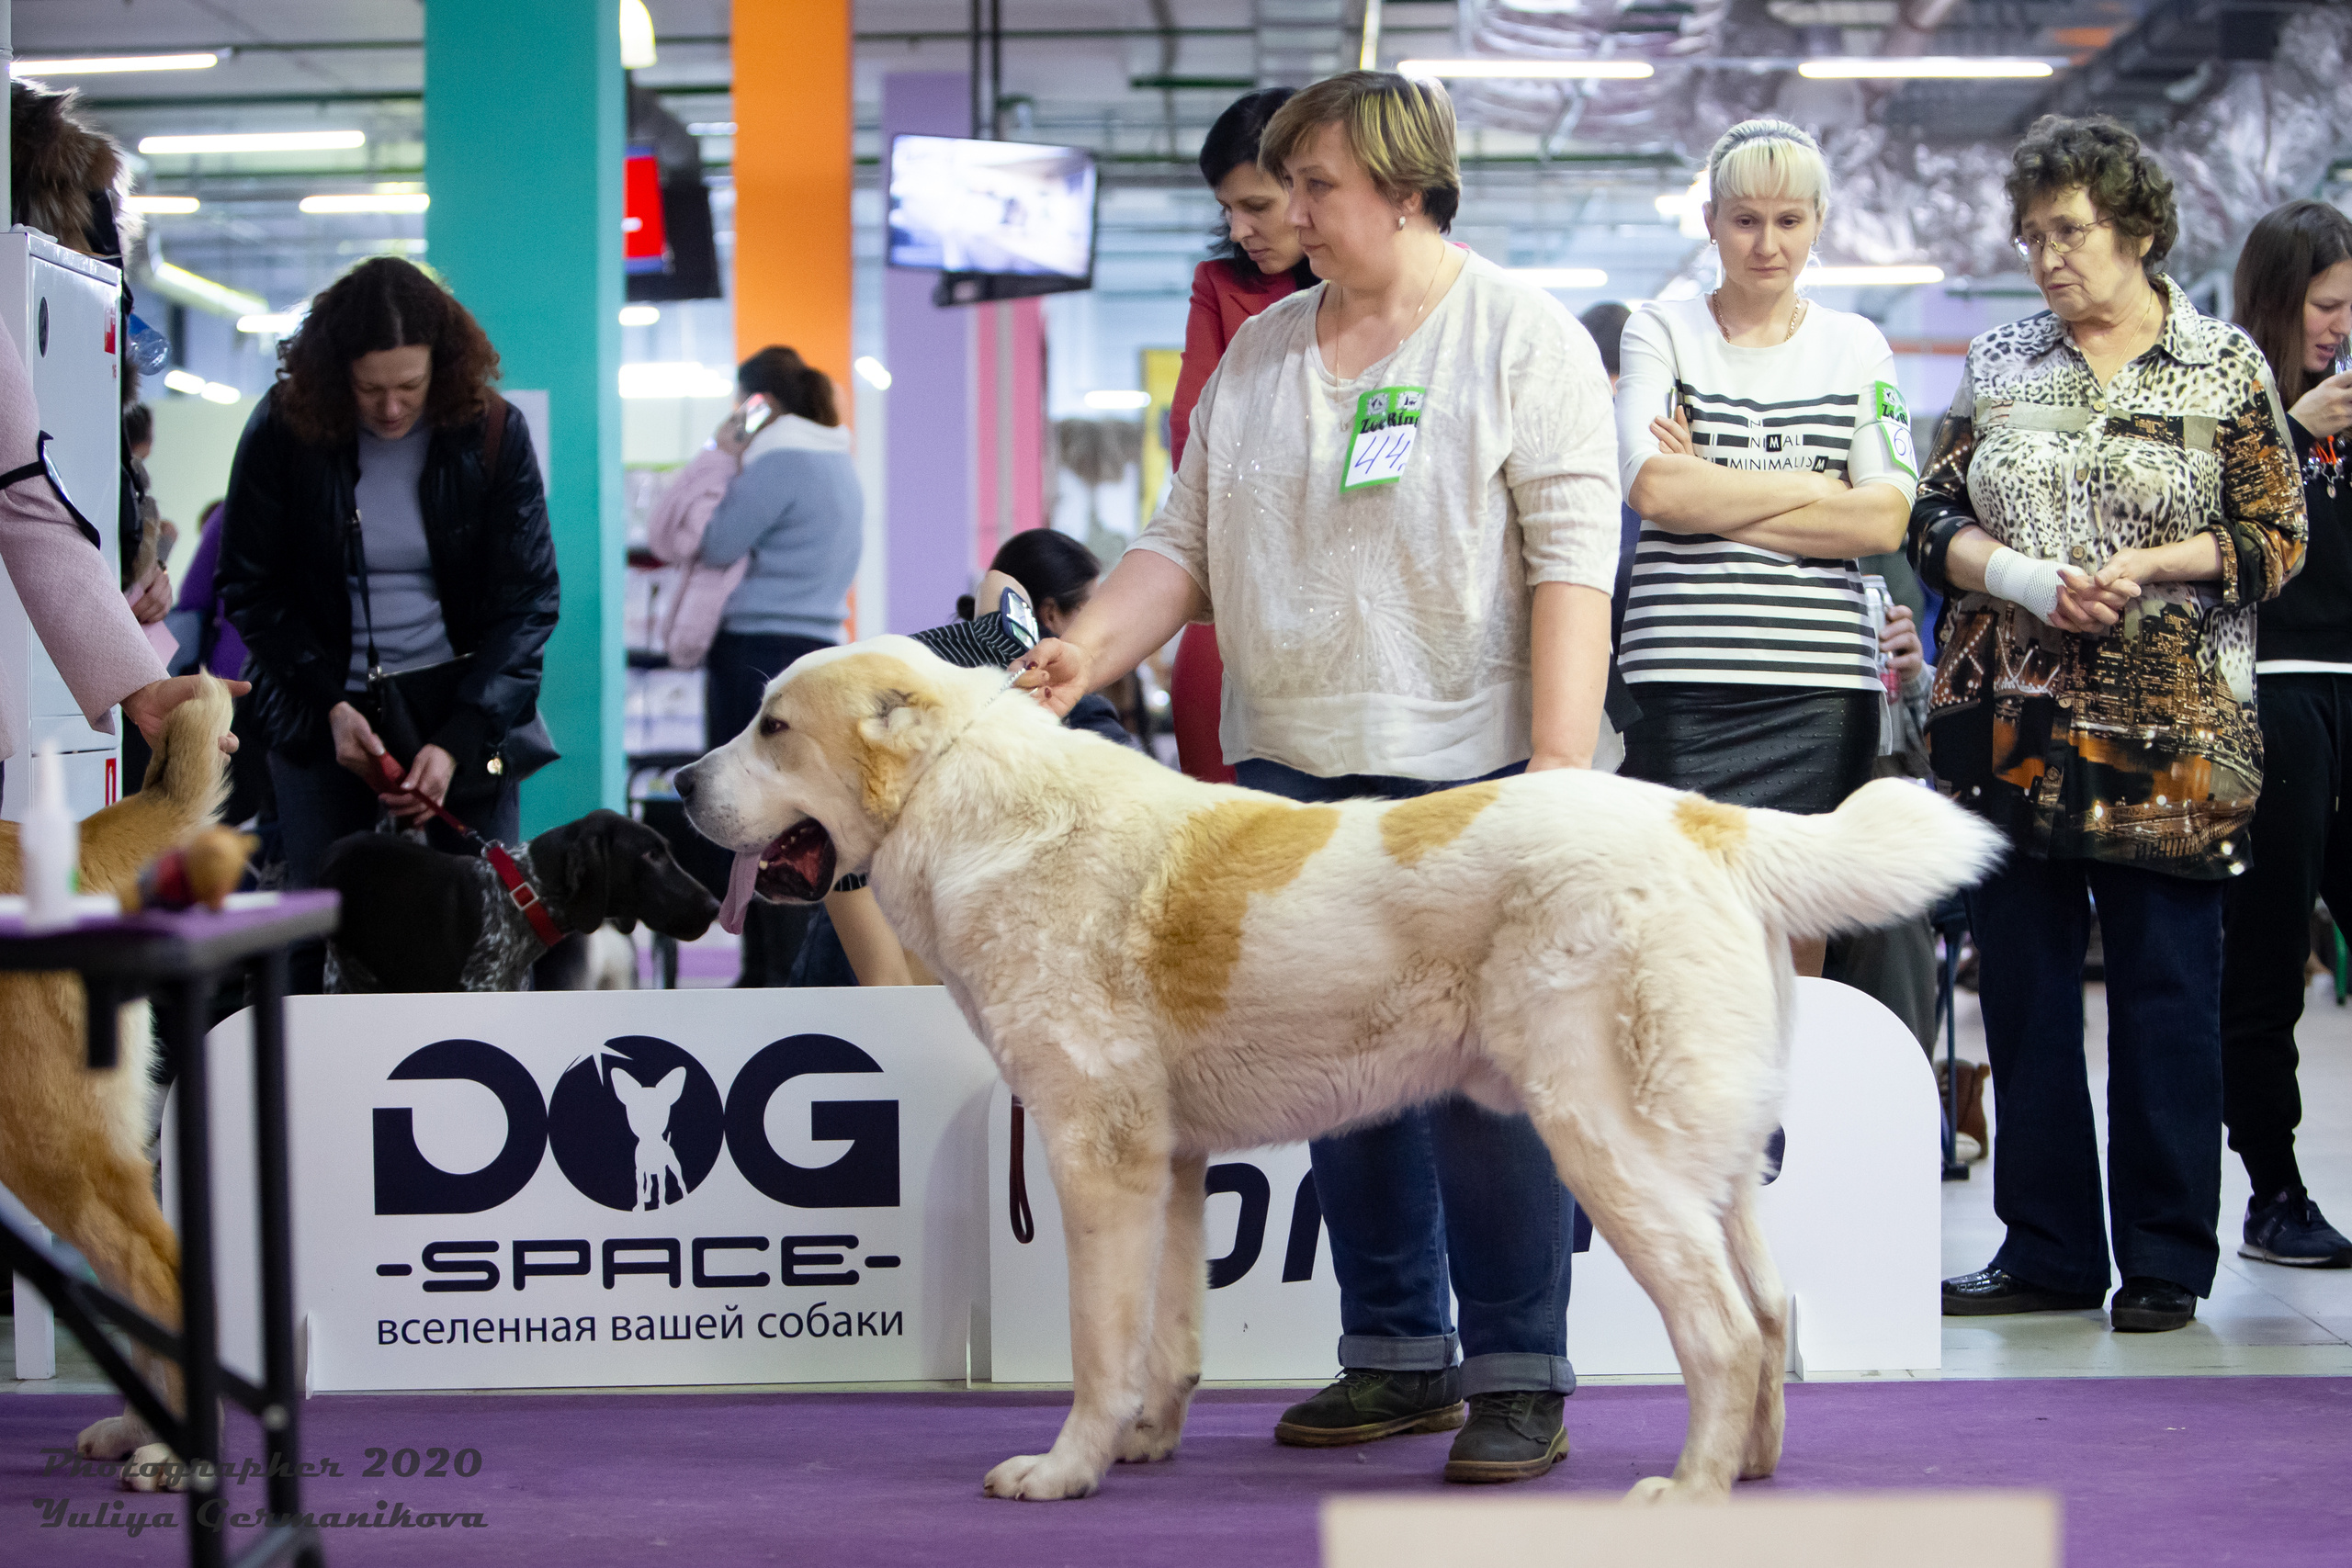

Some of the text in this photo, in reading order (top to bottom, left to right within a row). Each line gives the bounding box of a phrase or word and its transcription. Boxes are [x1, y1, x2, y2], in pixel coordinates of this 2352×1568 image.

[373, 1033, 900, 1215] DOG
[378, 1302, 903, 1346] вселенная вашей собаки
